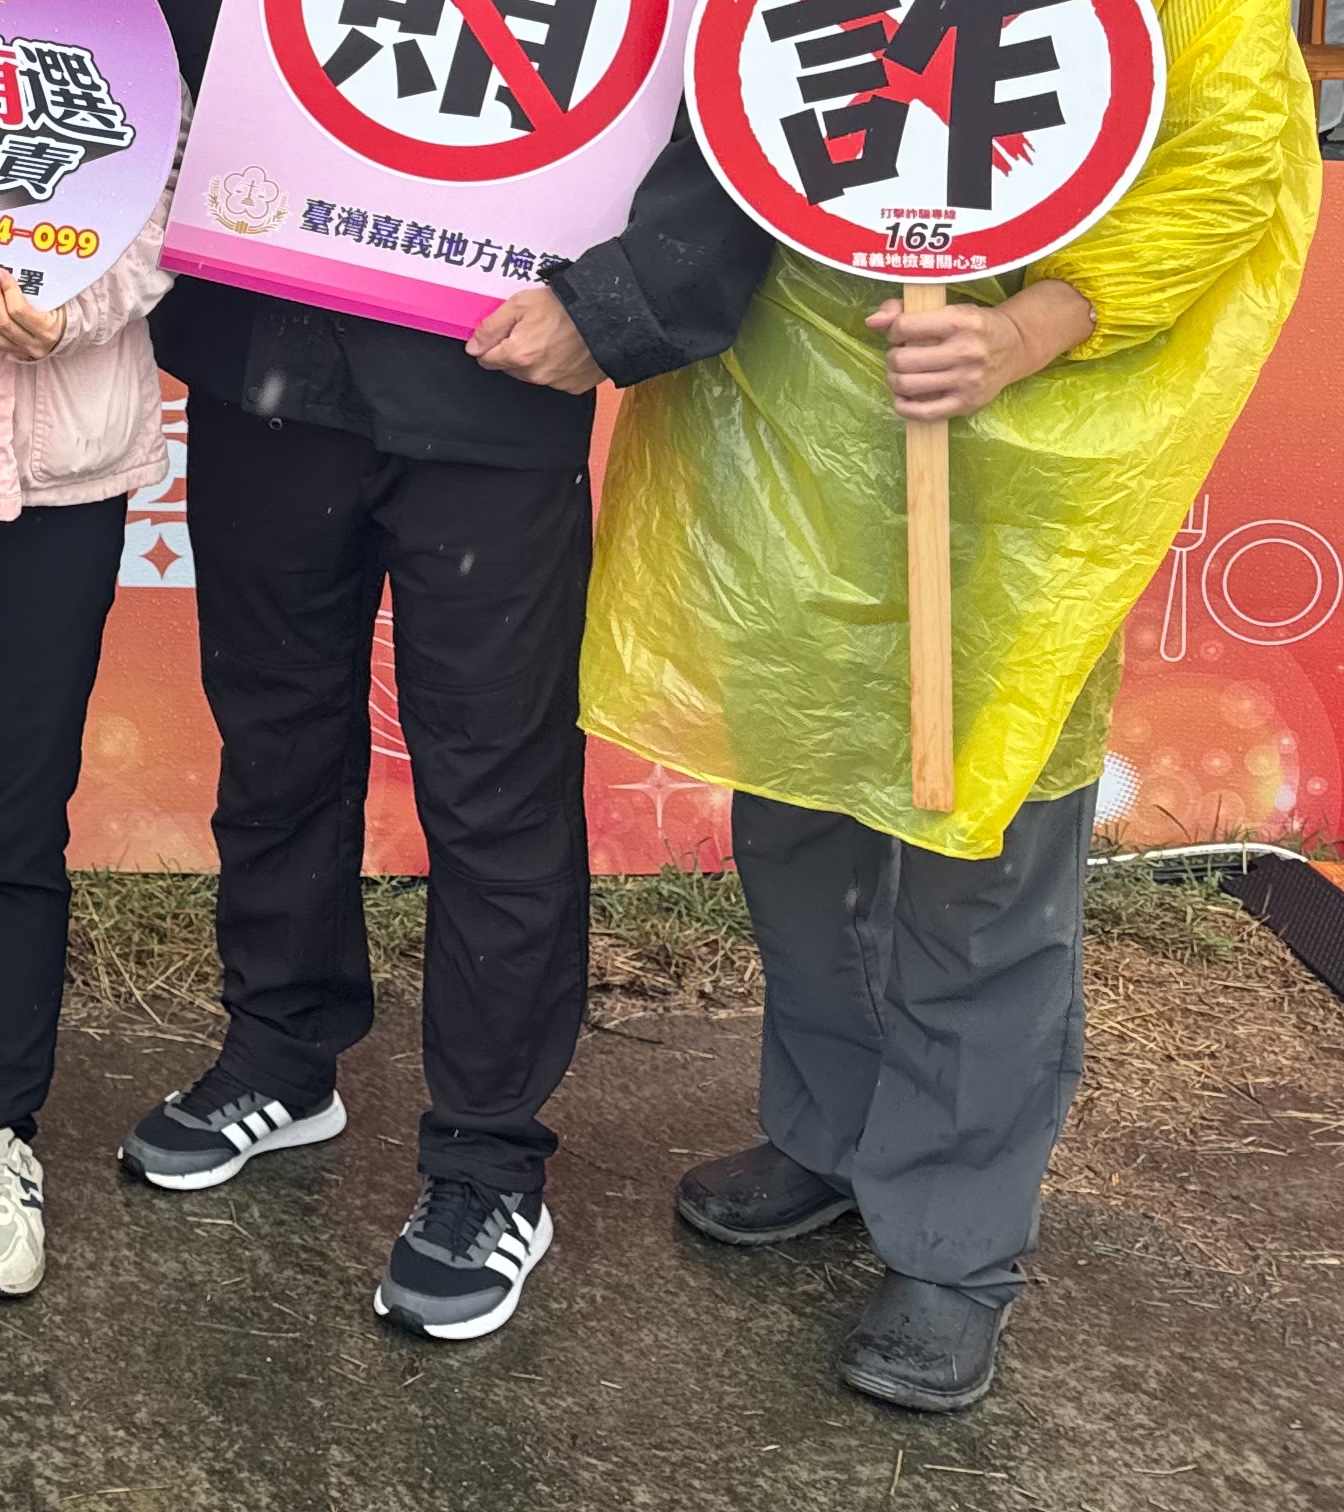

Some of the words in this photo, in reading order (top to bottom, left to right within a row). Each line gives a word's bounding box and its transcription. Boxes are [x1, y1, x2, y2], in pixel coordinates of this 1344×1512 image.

[884, 221, 954, 250] 165
[851, 251, 988, 270] 嘉義地檢署關心您
